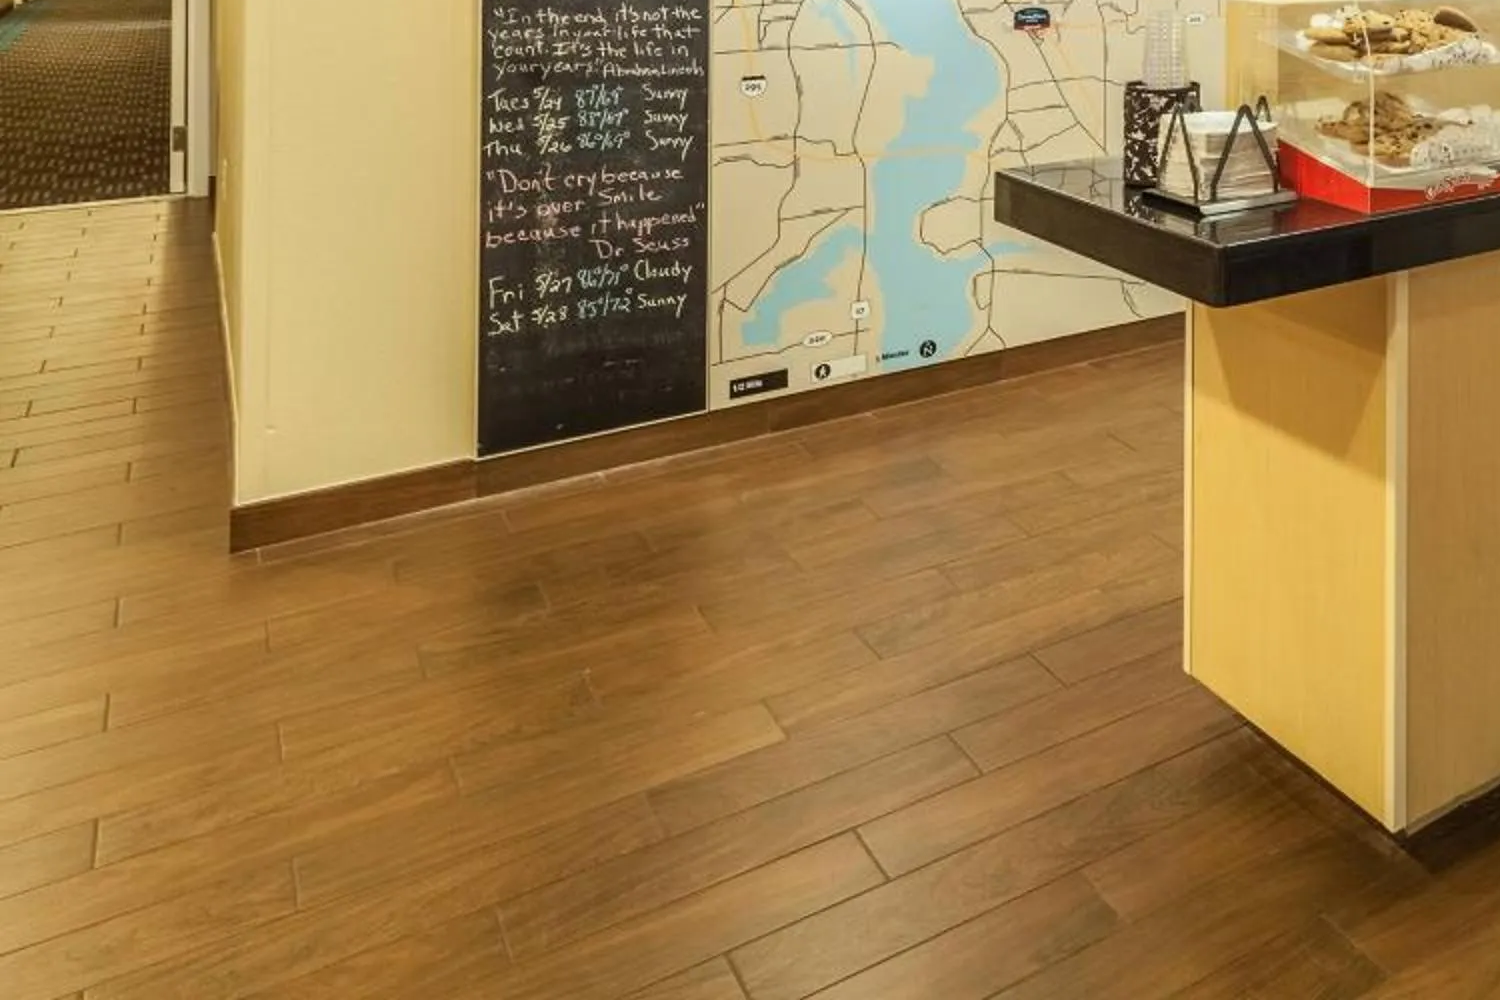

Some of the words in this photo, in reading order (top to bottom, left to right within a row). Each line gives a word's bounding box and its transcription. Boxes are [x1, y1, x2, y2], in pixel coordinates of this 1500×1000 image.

[536, 7, 571, 25] the
[643, 6, 670, 22] not
[671, 5, 703, 20] the
[487, 26, 545, 42] years
[616, 25, 648, 41] life
[651, 23, 701, 40] that
[552, 40, 592, 57] It's
[595, 41, 627, 57] the
[634, 41, 664, 57] life
[671, 43, 689, 57] in
[493, 60, 541, 81] your
[488, 88, 529, 112] Tues
[642, 83, 689, 110] Sunny
[489, 118, 524, 134] Wed
[643, 110, 689, 132] Sunny
[484, 140, 523, 157] Thu
[536, 134, 572, 155] 5/26
[645, 129, 694, 162] Sunny
[563, 171, 597, 197] cry
[601, 163, 684, 185] because
[489, 201, 527, 223] it's
[536, 200, 585, 217] over
[485, 225, 582, 249] because
[591, 211, 612, 234] it
[631, 236, 690, 253] Seuss
[488, 275, 524, 310] Fri
[535, 270, 573, 299] 5/27
[633, 259, 693, 284] Cloudy
[487, 309, 524, 337] Sat
[637, 292, 688, 319] Sunny
